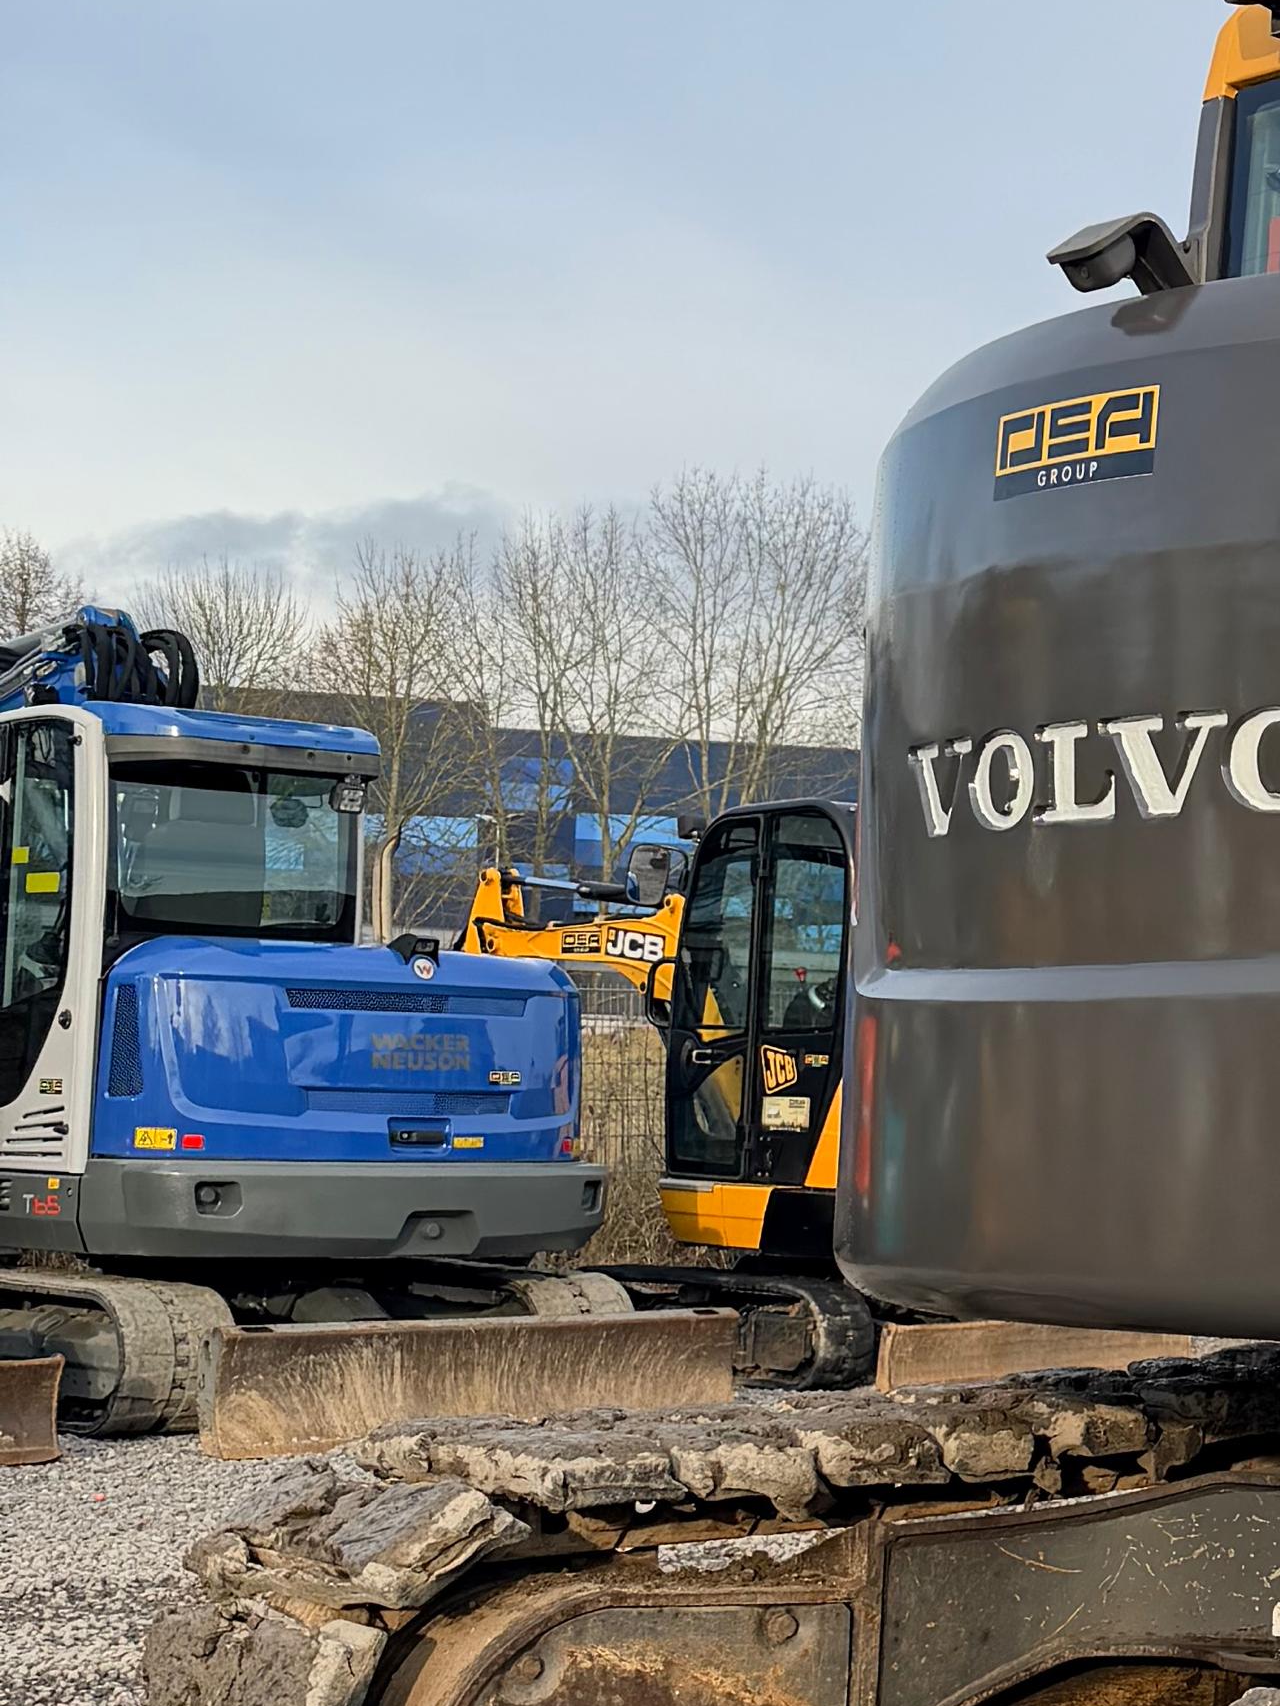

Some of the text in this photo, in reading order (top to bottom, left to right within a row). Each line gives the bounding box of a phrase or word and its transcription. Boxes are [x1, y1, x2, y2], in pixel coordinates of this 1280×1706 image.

[1037, 461, 1099, 487] GROUP
[606, 929, 665, 962] JCB
[371, 1033, 470, 1051] WACKER
[371, 1051, 471, 1071] NEUSON
[766, 1050, 794, 1089] JCB
